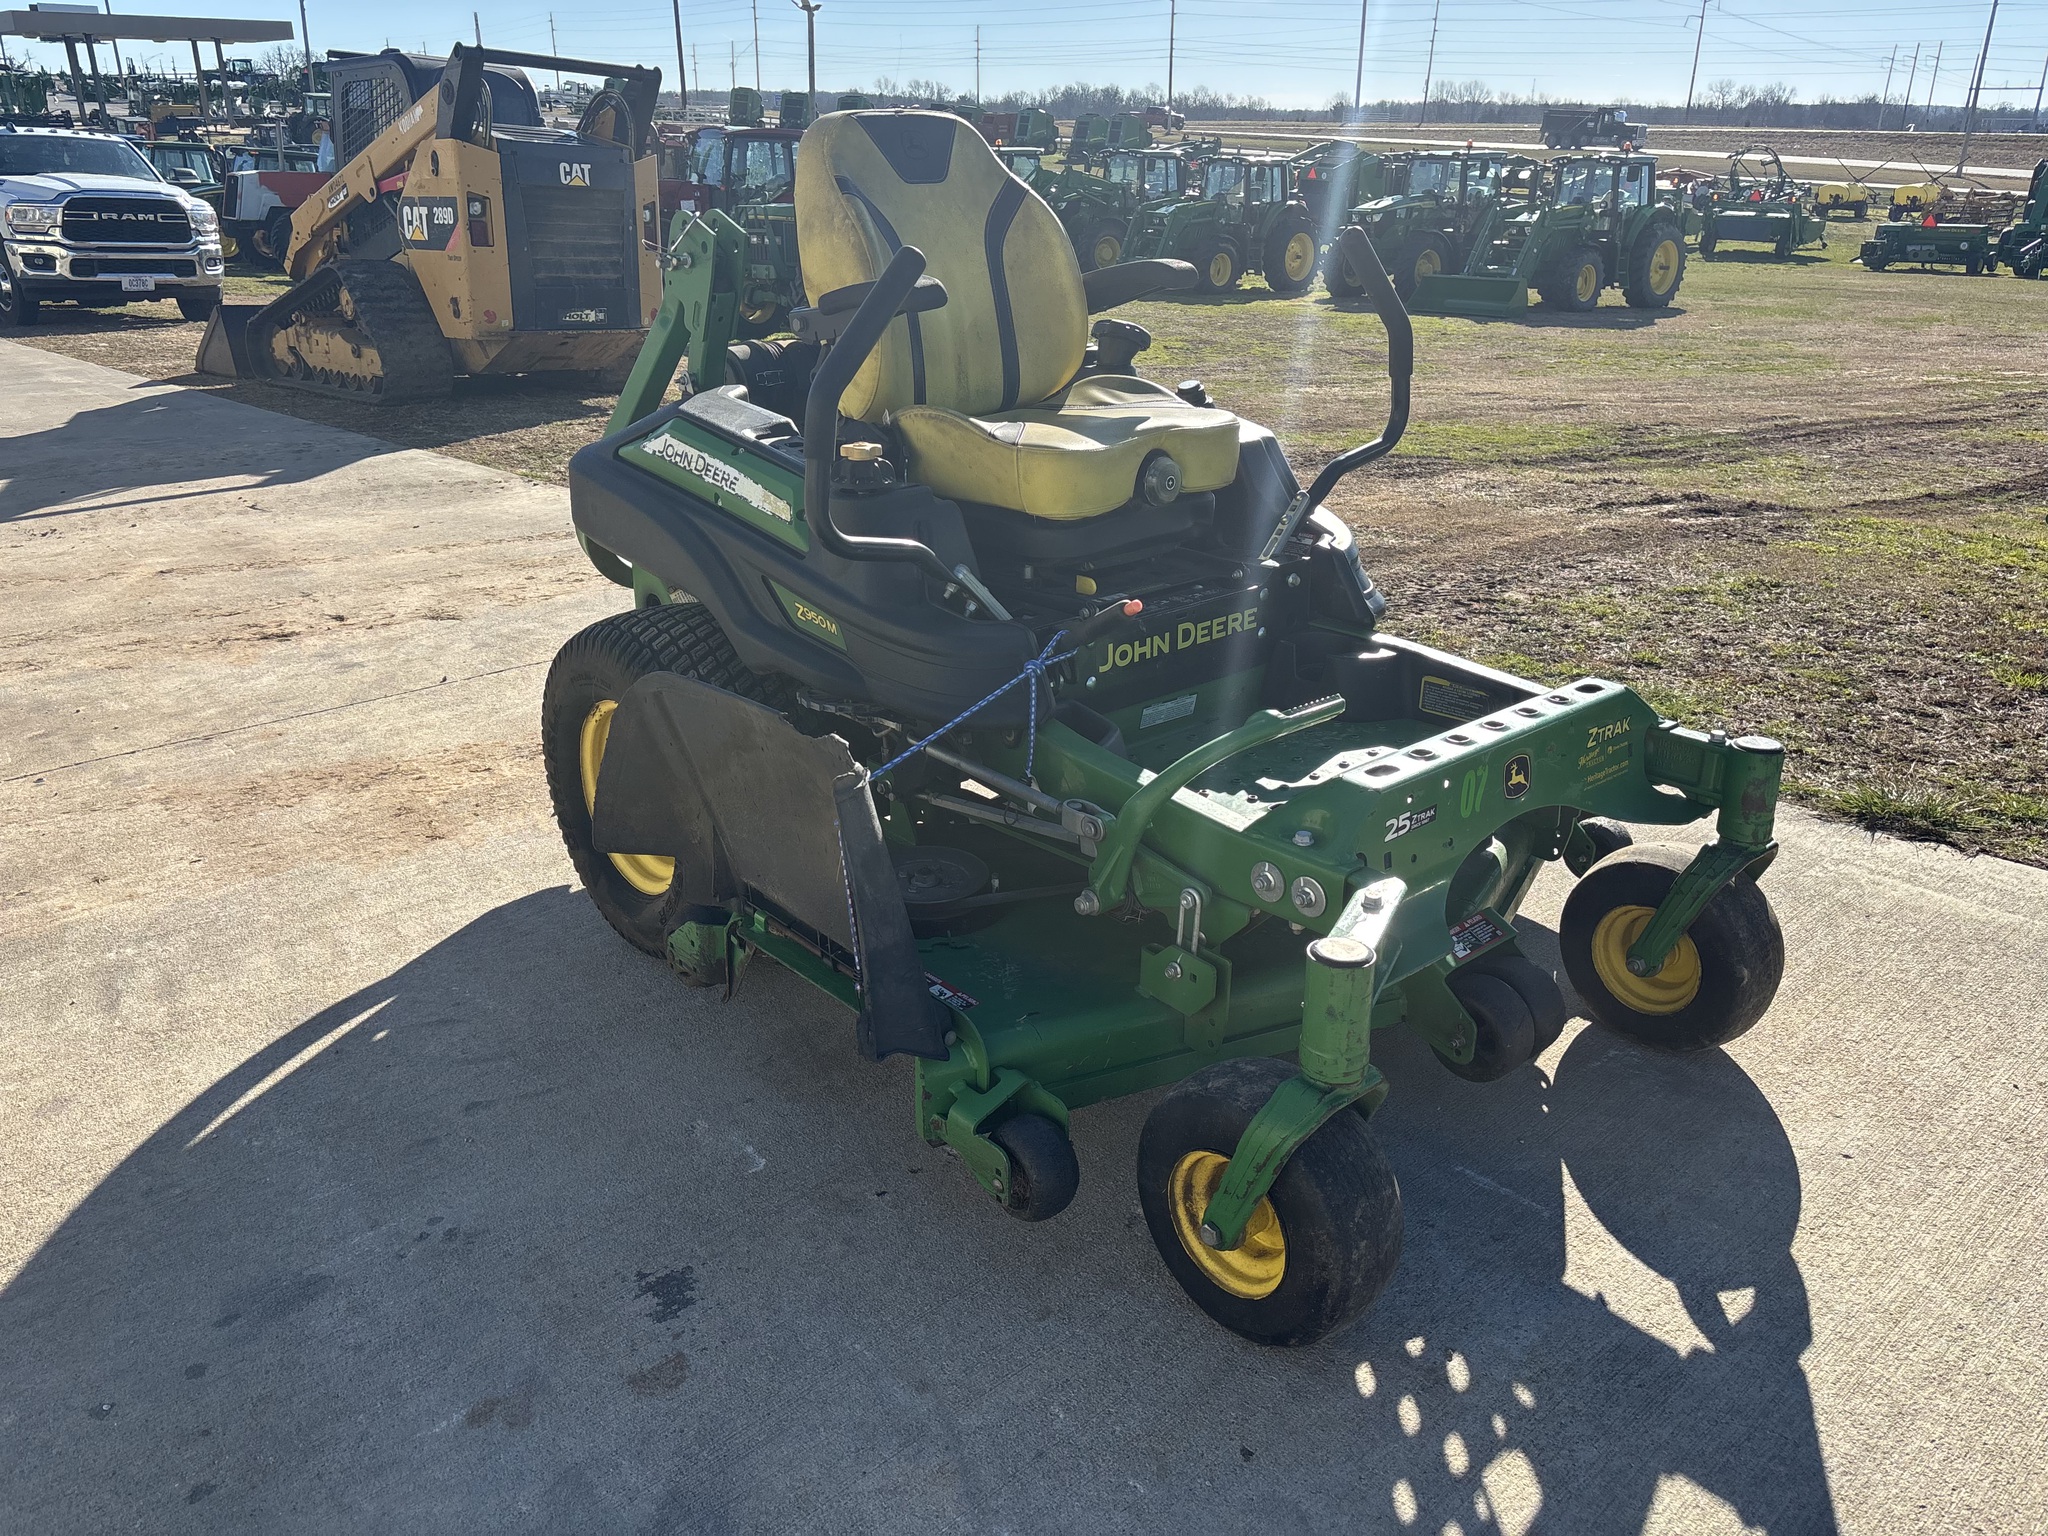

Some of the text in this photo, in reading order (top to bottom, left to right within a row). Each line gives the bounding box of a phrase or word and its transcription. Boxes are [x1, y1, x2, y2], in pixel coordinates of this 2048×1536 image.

[559, 162, 591, 187] CAT
[101, 212, 155, 221] RAM
[402, 205, 455, 241] CAT 289D
[564, 311, 591, 321] HOLT
[657, 438, 740, 492] JOHN DEERE
[794, 602, 838, 635] Z950M
[1098, 607, 1258, 673] JOHN DEERE
[1587, 716, 1631, 748] ZTRAK
[1384, 807, 1435, 843] 25 ZTRAK
